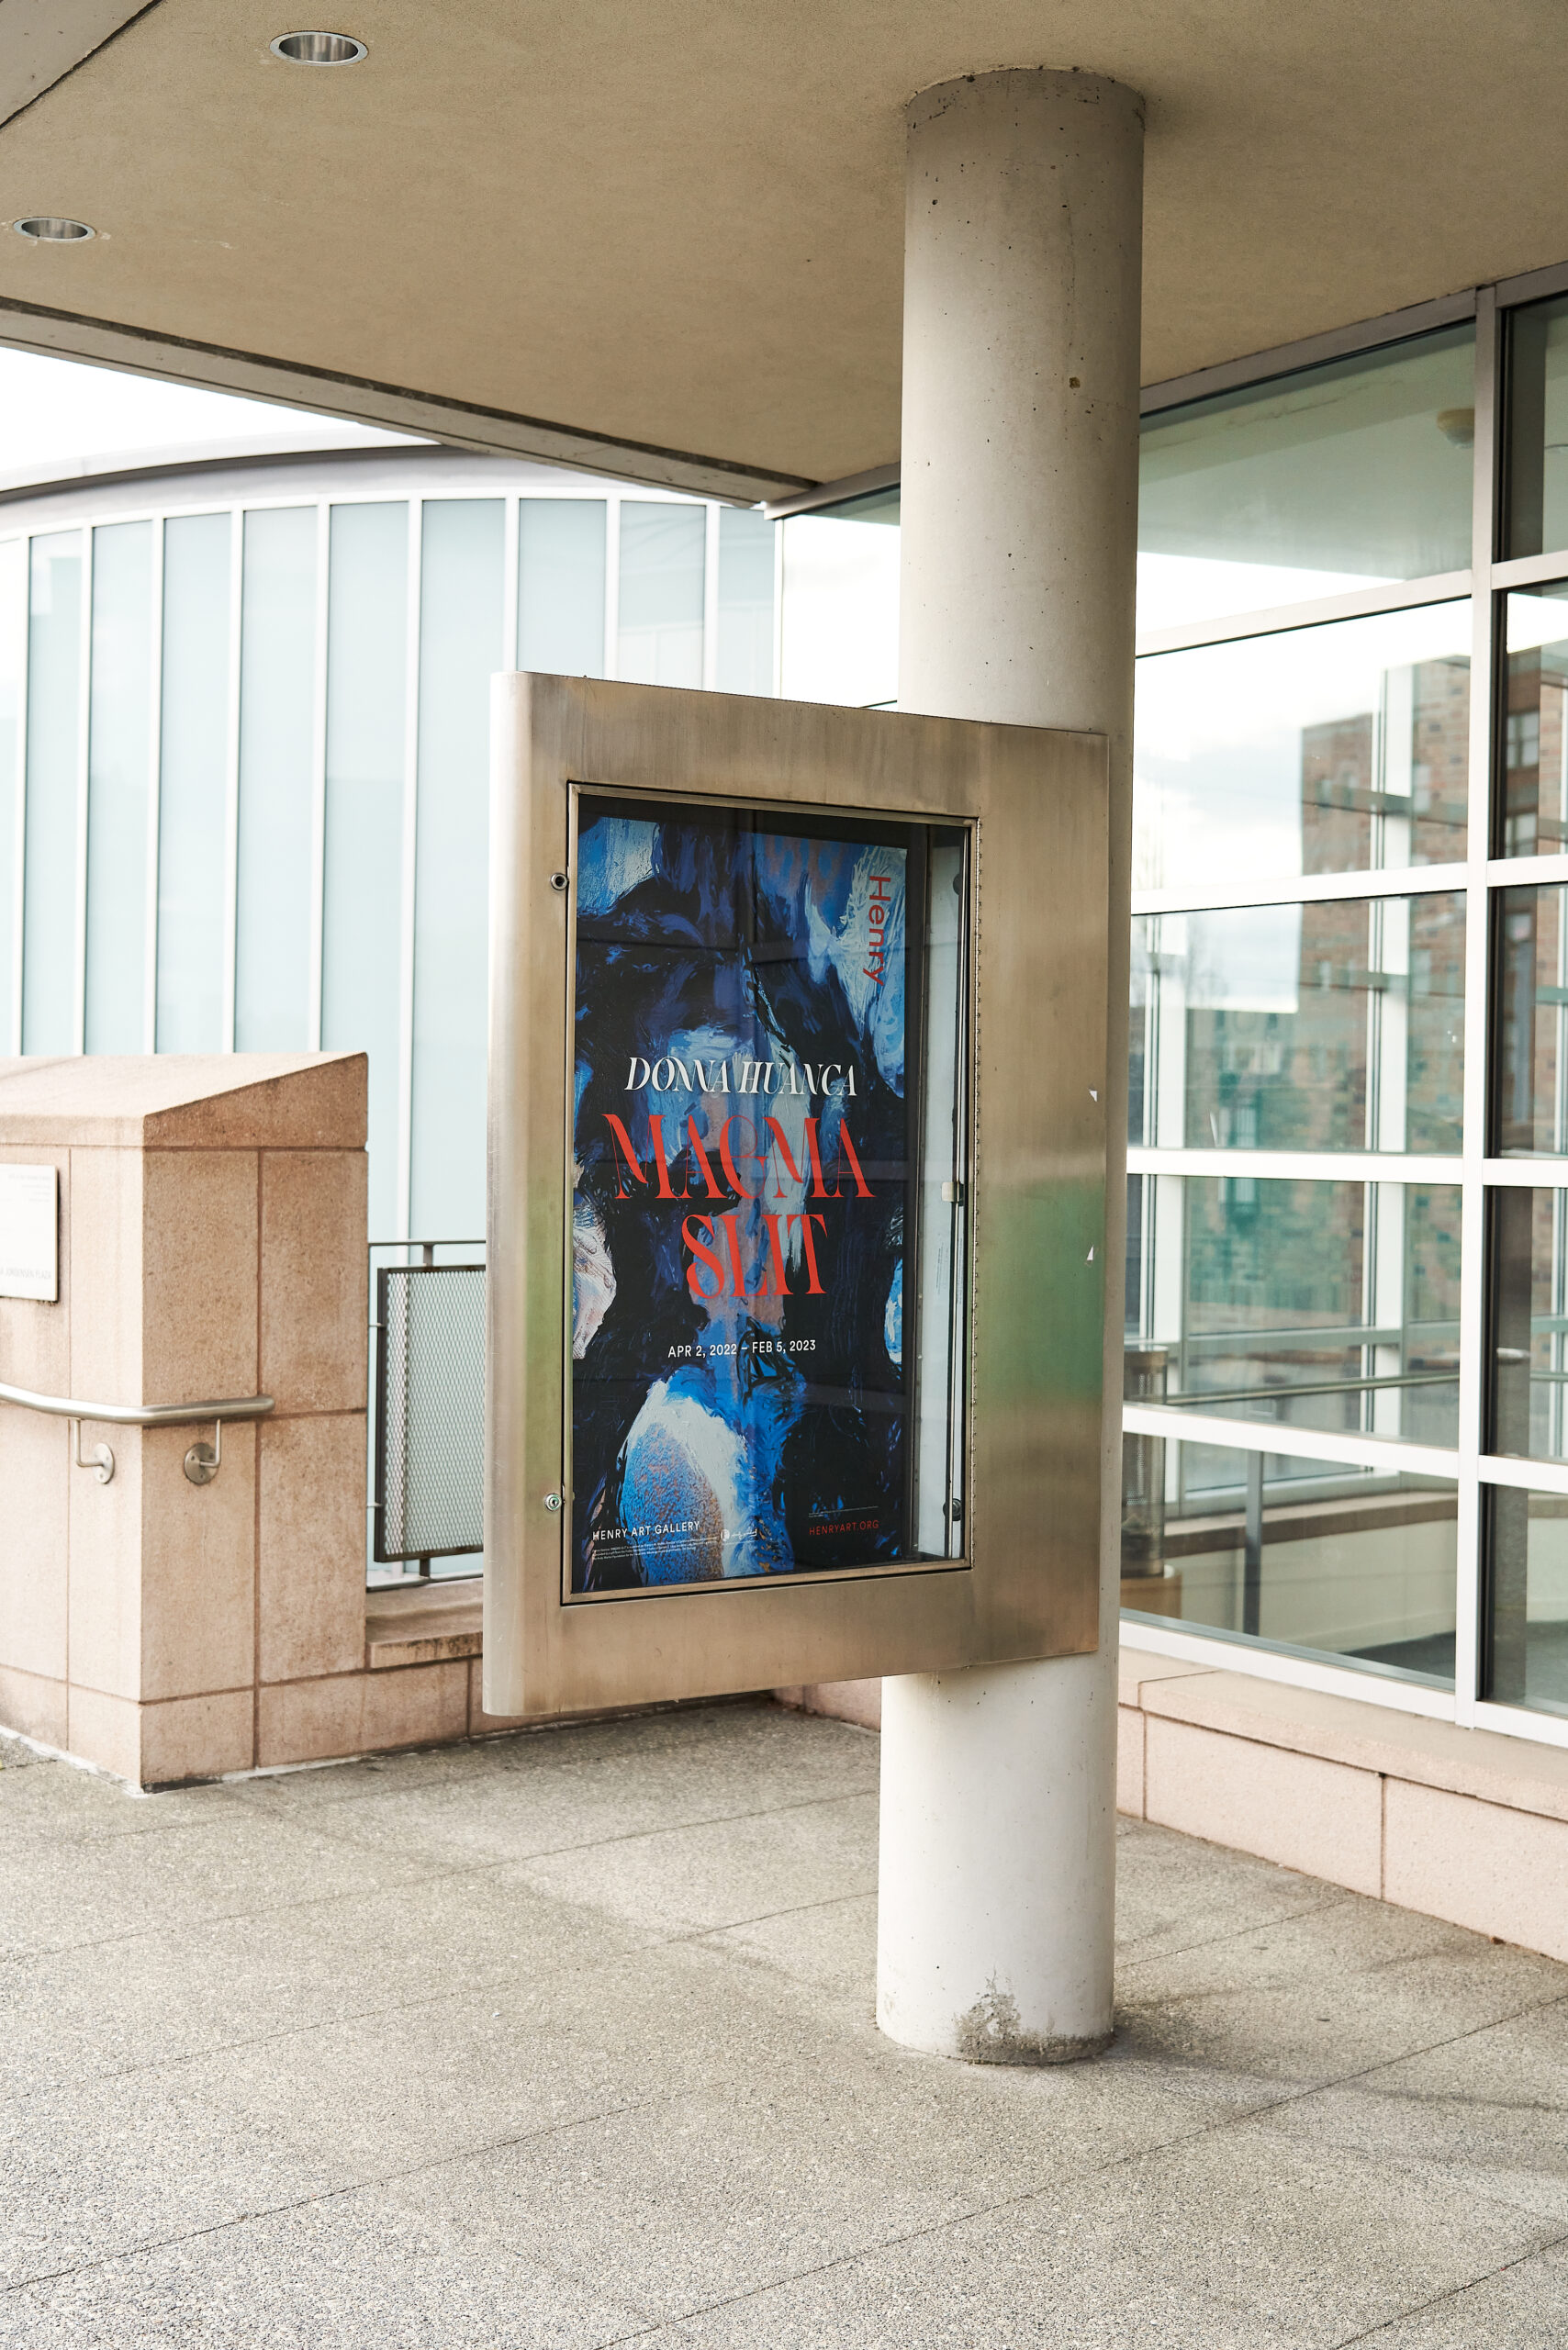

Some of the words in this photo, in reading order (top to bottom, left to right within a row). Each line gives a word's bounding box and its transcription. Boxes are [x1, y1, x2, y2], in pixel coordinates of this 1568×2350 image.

[863, 876, 891, 987] Henry
[624, 1056, 731, 1092] DONNA
[737, 1059, 857, 1096] HUANCA
[601, 1113, 875, 1200] MAGMA
[682, 1214, 828, 1299] SLIT
[668, 1345, 692, 1358] APR
[695, 1345, 706, 1358] 2,
[710, 1343, 737, 1356] 2022
[752, 1341, 773, 1353] FEB
[777, 1341, 787, 1354] 5,
[790, 1339, 816, 1351] 2023
[592, 1528, 628, 1540] HENRY
[631, 1526, 652, 1537] ART
[655, 1521, 700, 1534] GALLERY
[809, 1519, 879, 1536] HENRYART.ORG
